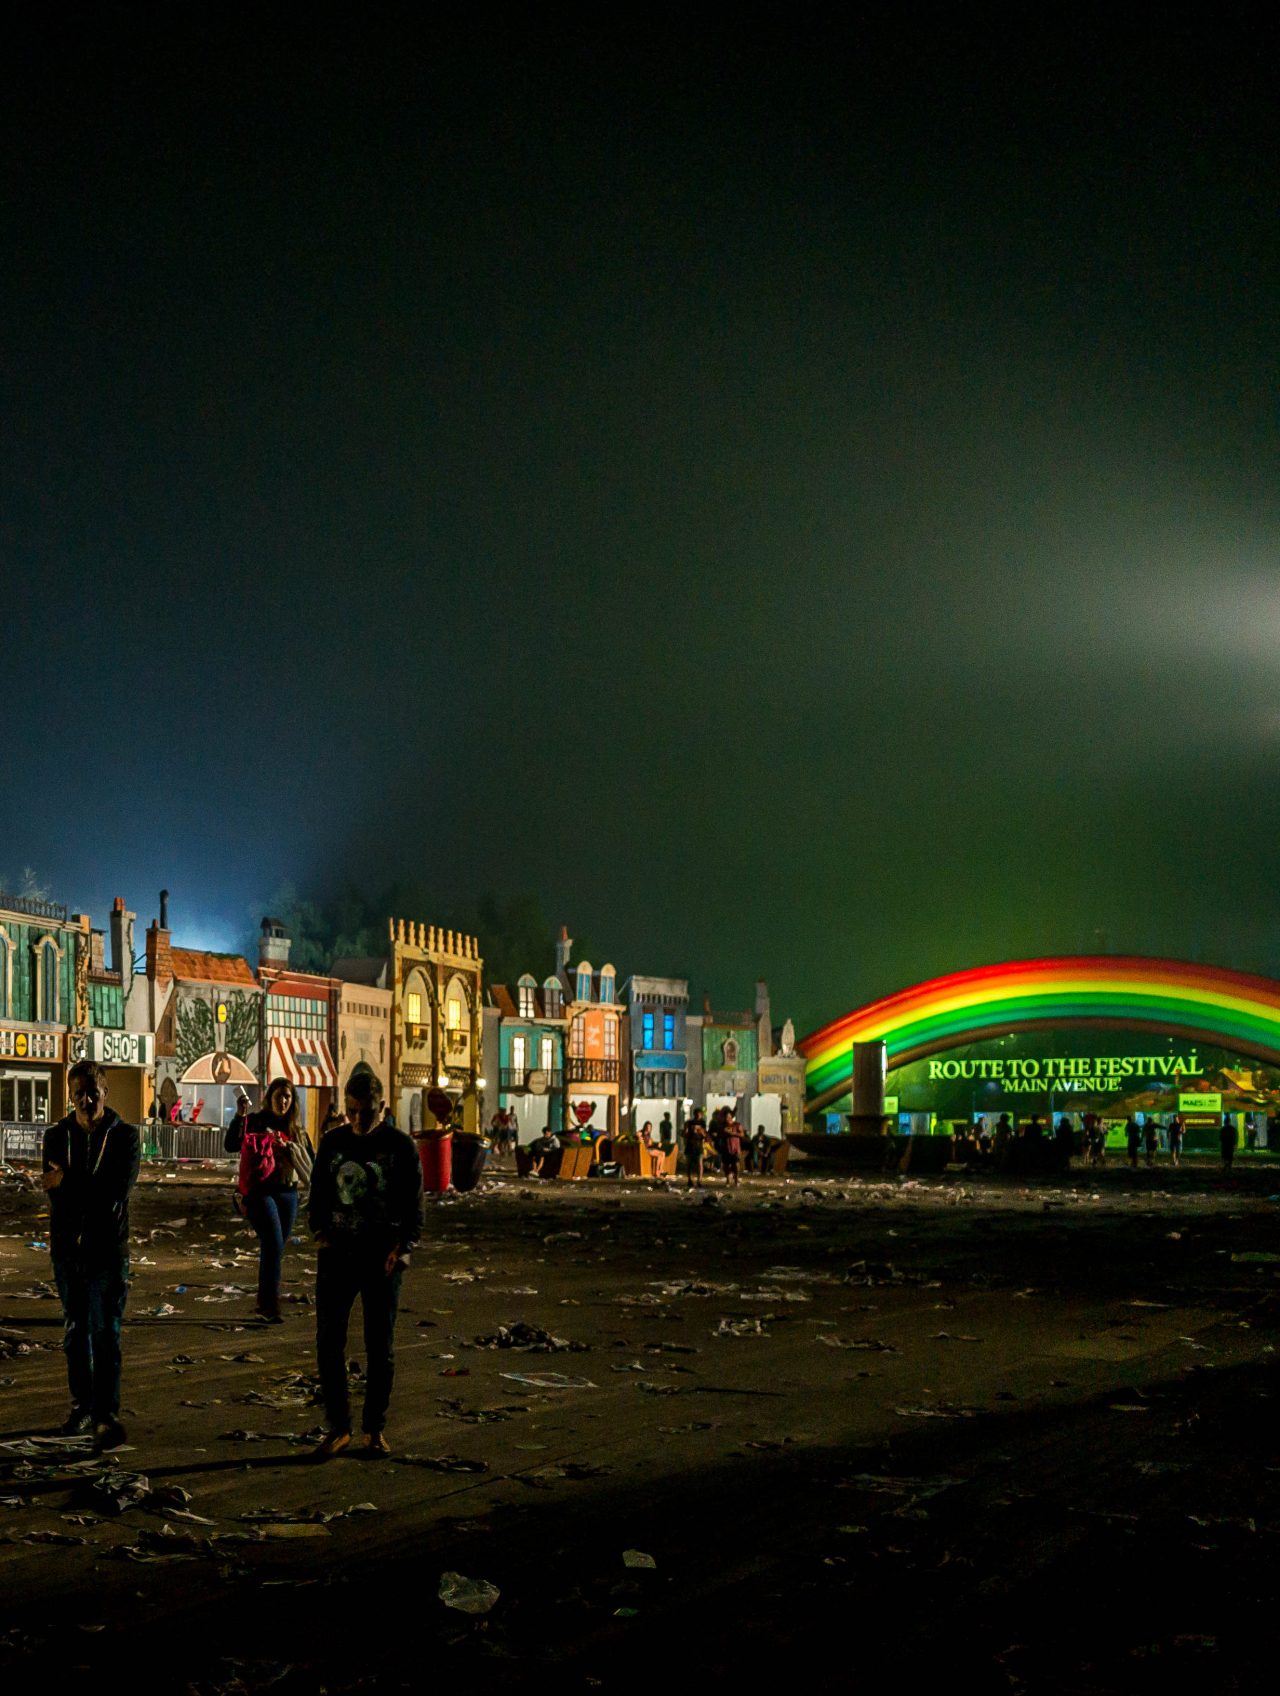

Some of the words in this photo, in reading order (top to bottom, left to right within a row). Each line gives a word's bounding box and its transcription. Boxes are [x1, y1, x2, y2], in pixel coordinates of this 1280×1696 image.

[103, 1035, 138, 1062] SHOP
[928, 1060, 1005, 1080] ROUTE
[1007, 1059, 1040, 1079] TO
[1043, 1058, 1092, 1078] THE
[1094, 1055, 1205, 1077] FESTIVAL
